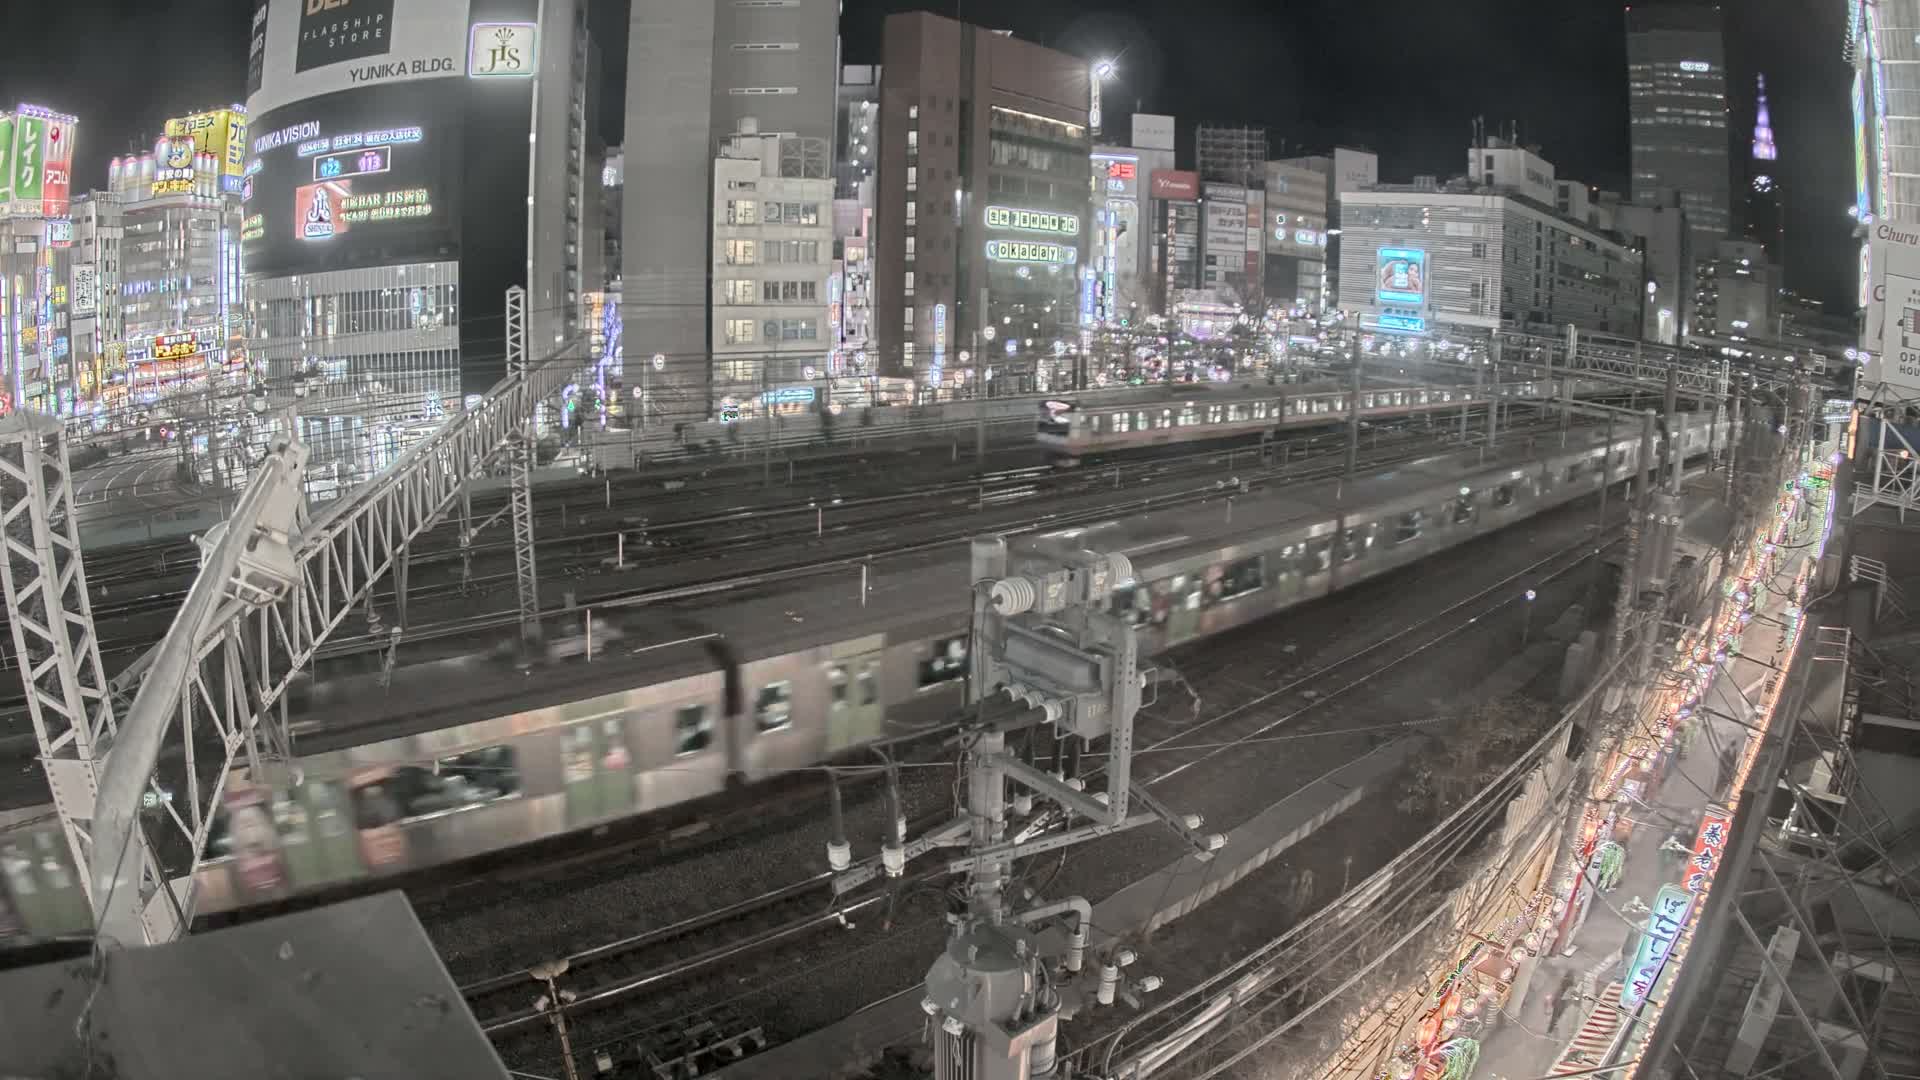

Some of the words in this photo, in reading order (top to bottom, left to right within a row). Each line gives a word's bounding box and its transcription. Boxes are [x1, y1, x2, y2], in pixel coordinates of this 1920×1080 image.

[304, 14, 383, 40] FLAGSHIP
[329, 28, 382, 48] STORE
[350, 62, 408, 82] YUNIKA
[412, 58, 457, 75] BLDG.
[254, 131, 282, 153] YUNIKA
[283, 120, 321, 143] VISION
[22, 120, 38, 189] レイク
[46, 168, 68, 185] アコム
[1877, 225, 1919, 246] Churu
